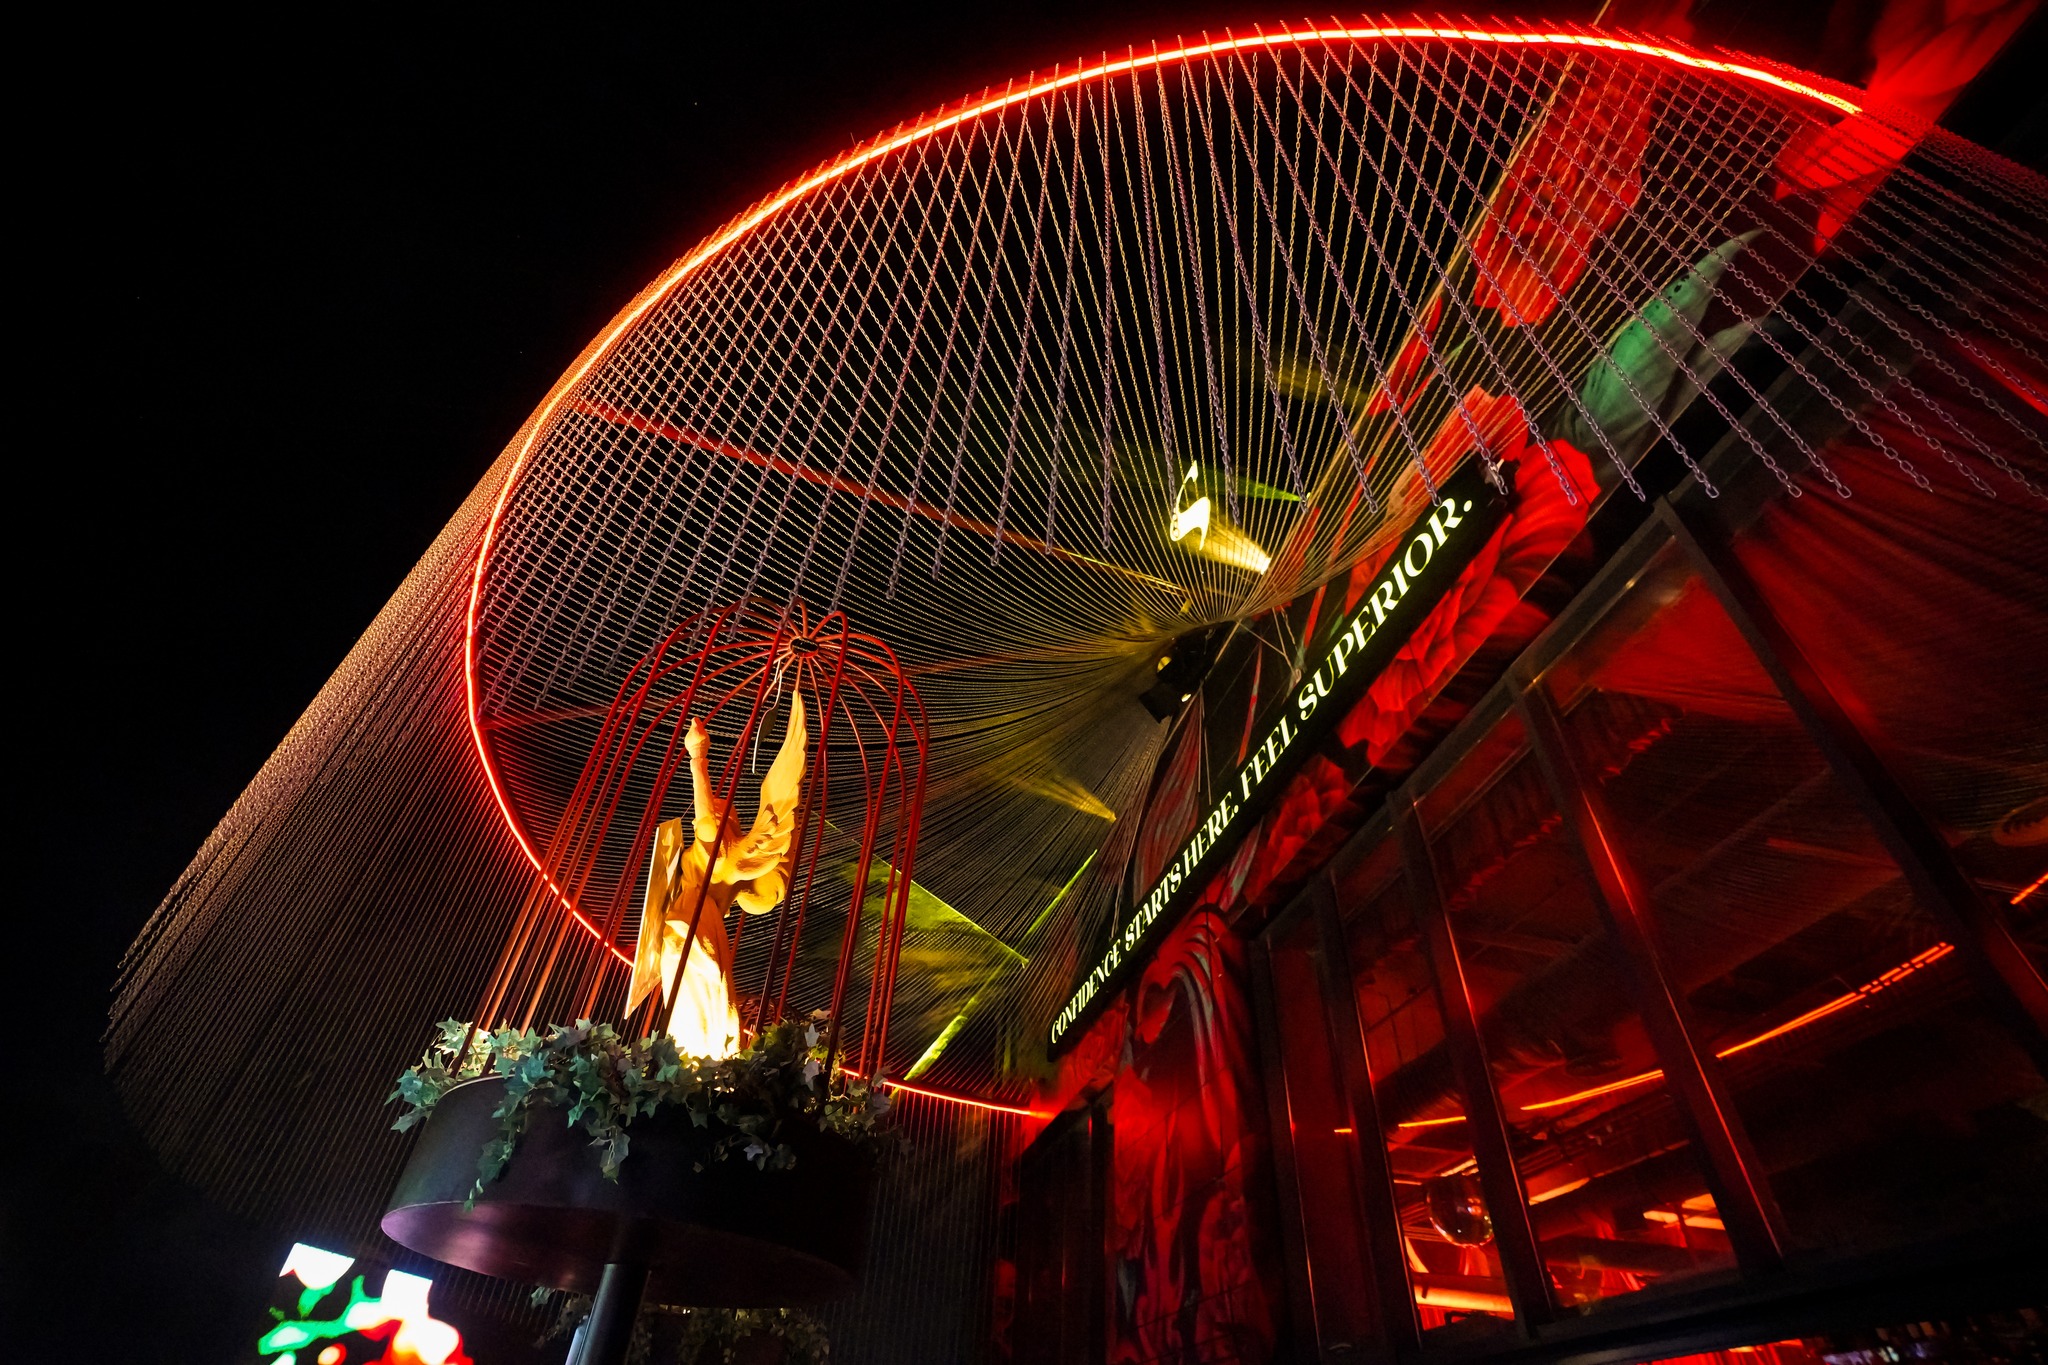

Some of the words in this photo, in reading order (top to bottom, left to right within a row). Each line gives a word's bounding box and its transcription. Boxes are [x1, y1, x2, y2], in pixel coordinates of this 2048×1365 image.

[1051, 938, 1121, 1044] CONFIDENCE
[1125, 863, 1183, 952] STARTS
[1183, 791, 1239, 879] HERE.
[1240, 715, 1298, 803] FEEL
[1298, 497, 1473, 721] SUPERIOR.
